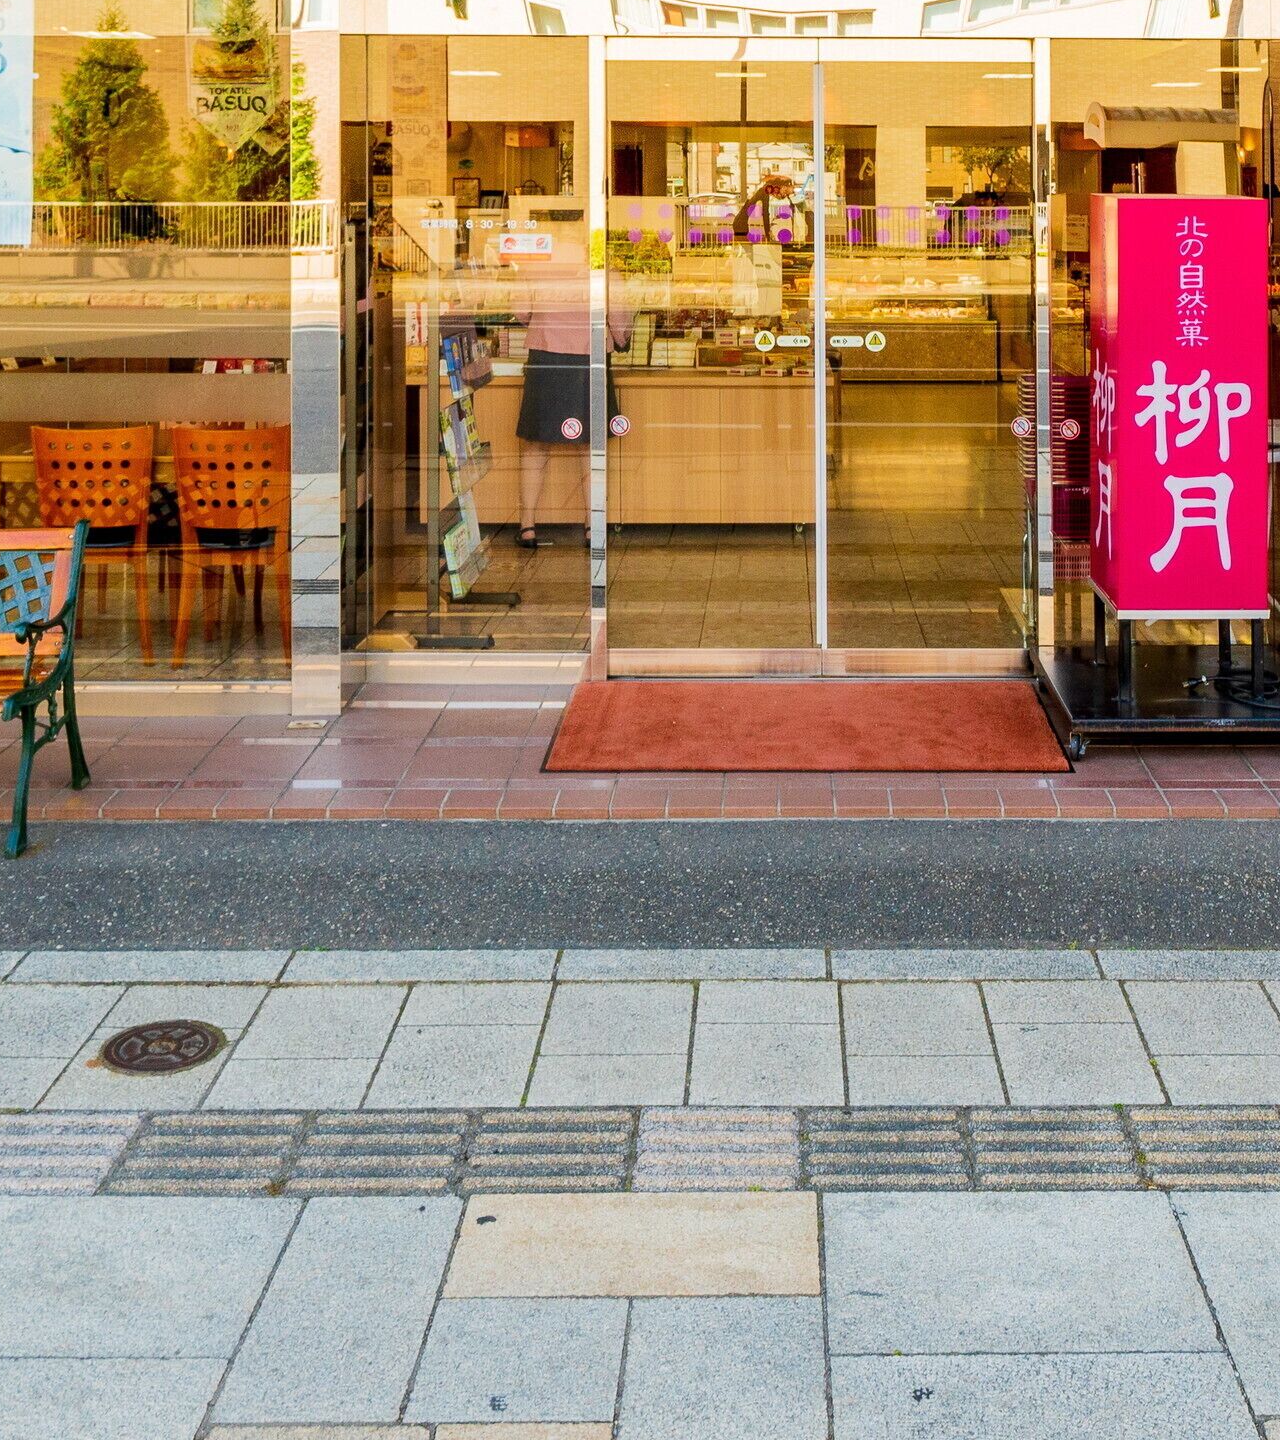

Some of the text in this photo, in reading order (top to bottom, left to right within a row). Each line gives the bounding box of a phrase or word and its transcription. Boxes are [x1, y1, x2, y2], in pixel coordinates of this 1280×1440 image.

[196, 95, 268, 116] BASUQ
[1175, 215, 1210, 348] 北の自然菓
[1092, 347, 1117, 561] 柳月
[1134, 359, 1252, 573] 柳月
